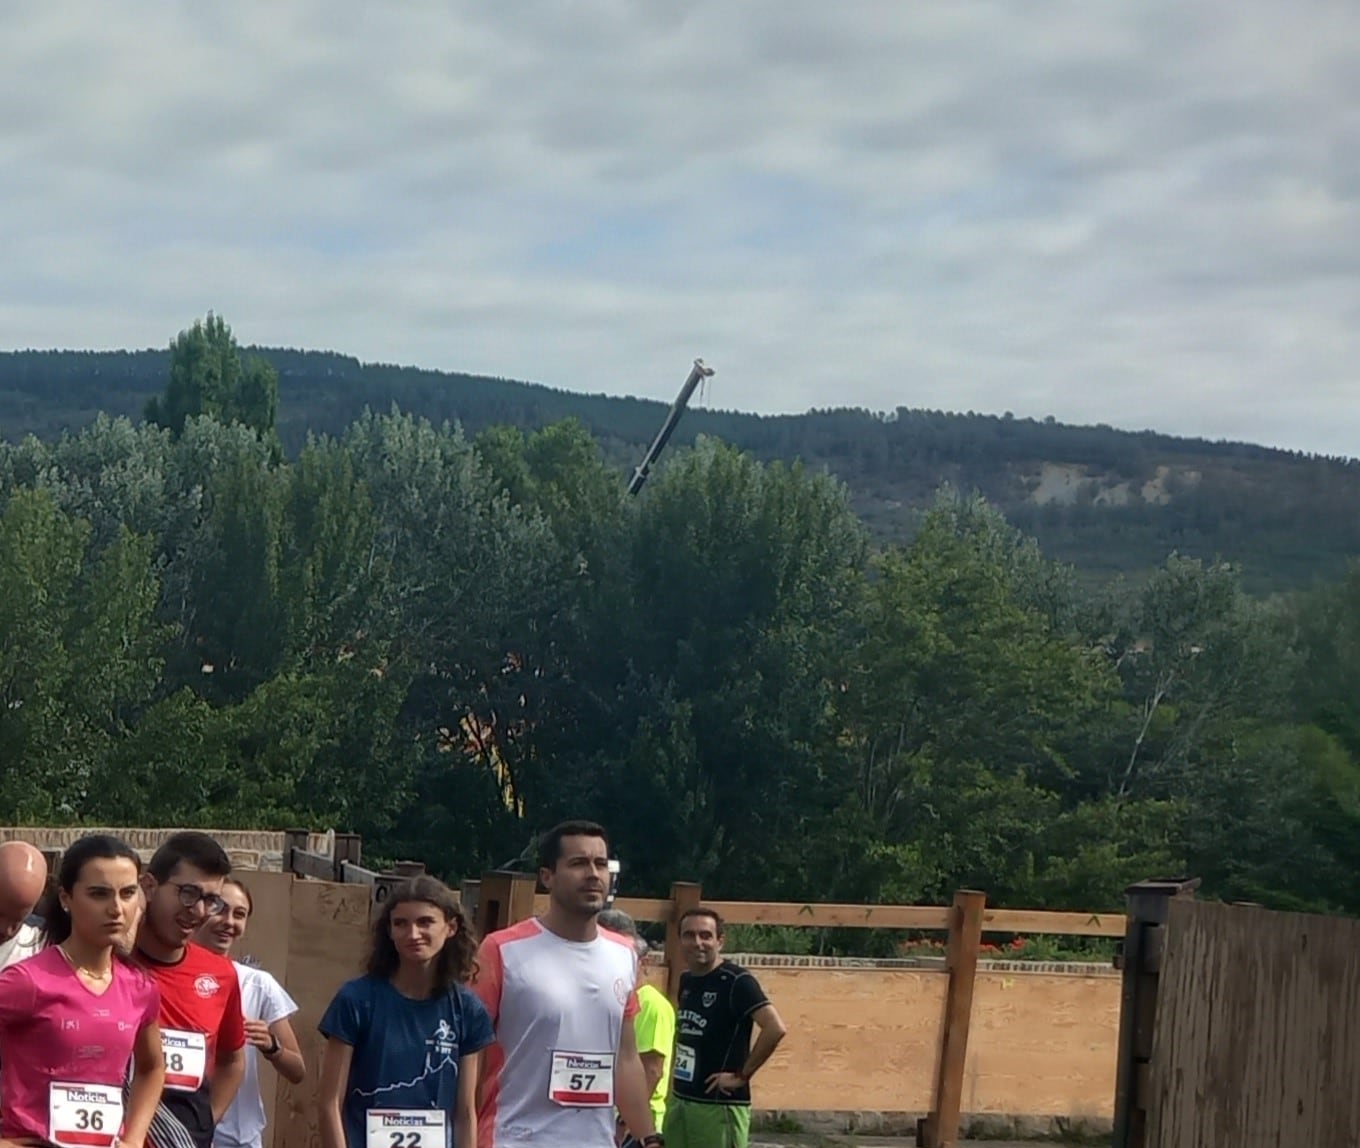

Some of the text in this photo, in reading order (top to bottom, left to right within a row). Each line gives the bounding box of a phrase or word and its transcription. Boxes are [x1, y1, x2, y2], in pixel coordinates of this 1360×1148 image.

[569, 1074, 596, 1091] 57
[68, 1090, 108, 1103] Noticias
[75, 1109, 104, 1131] 36
